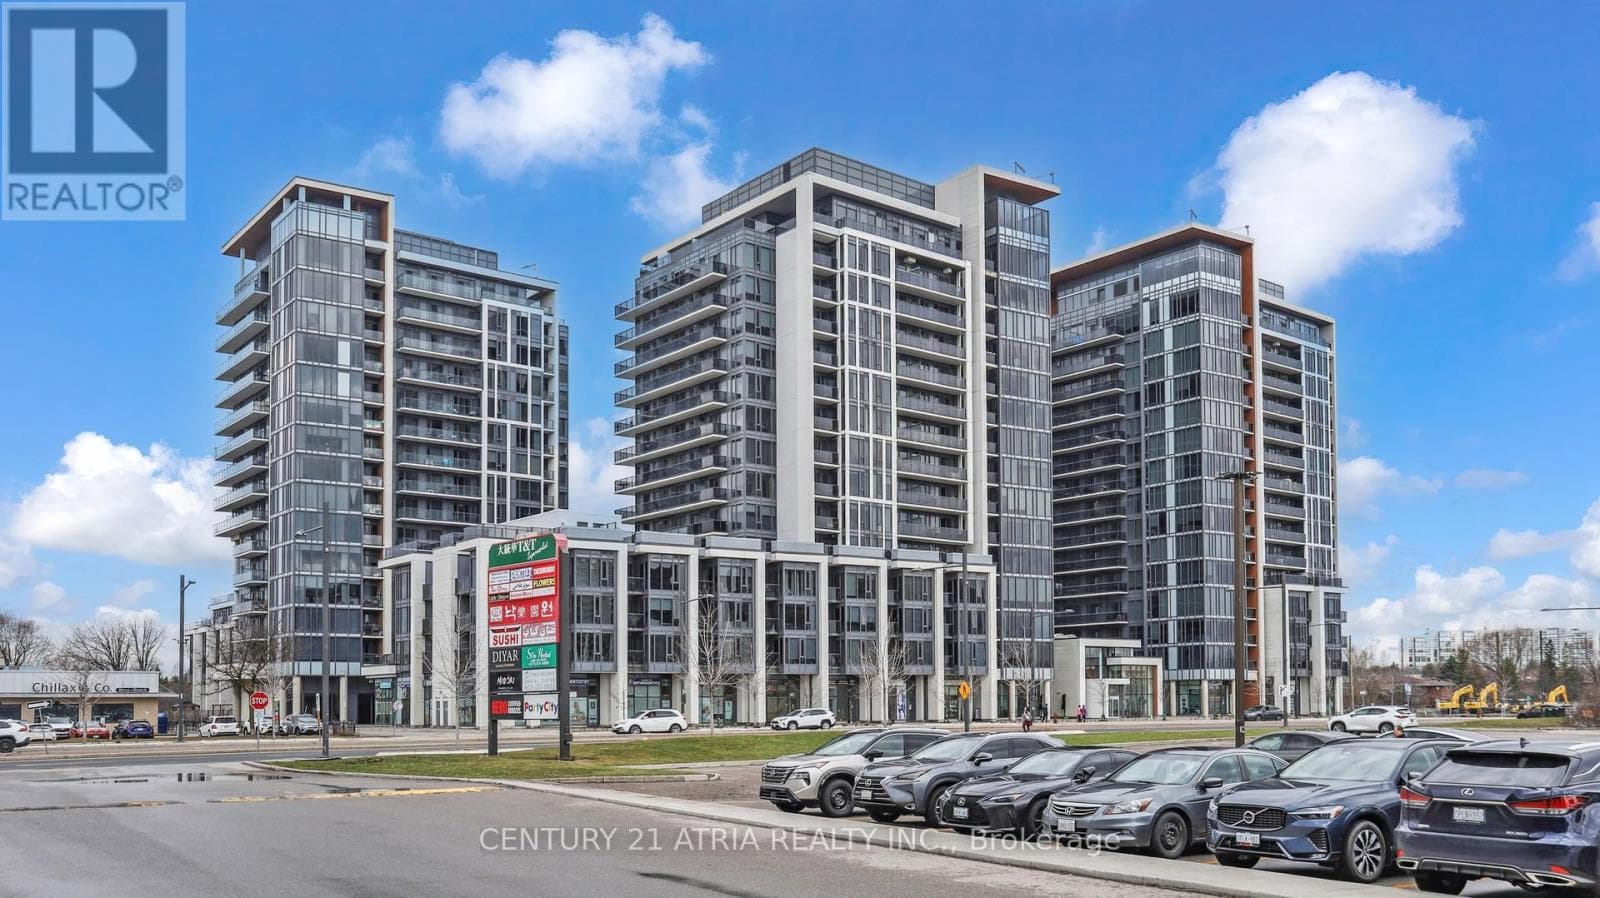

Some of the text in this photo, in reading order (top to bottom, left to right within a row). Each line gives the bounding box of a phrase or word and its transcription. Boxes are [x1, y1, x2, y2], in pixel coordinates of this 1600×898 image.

[533, 577, 556, 588] FLOWERS
[493, 633, 519, 646] SUSHI
[492, 649, 519, 663] DIYAR
[32, 682, 77, 693] Chillax
[251, 697, 268, 705] STOP
